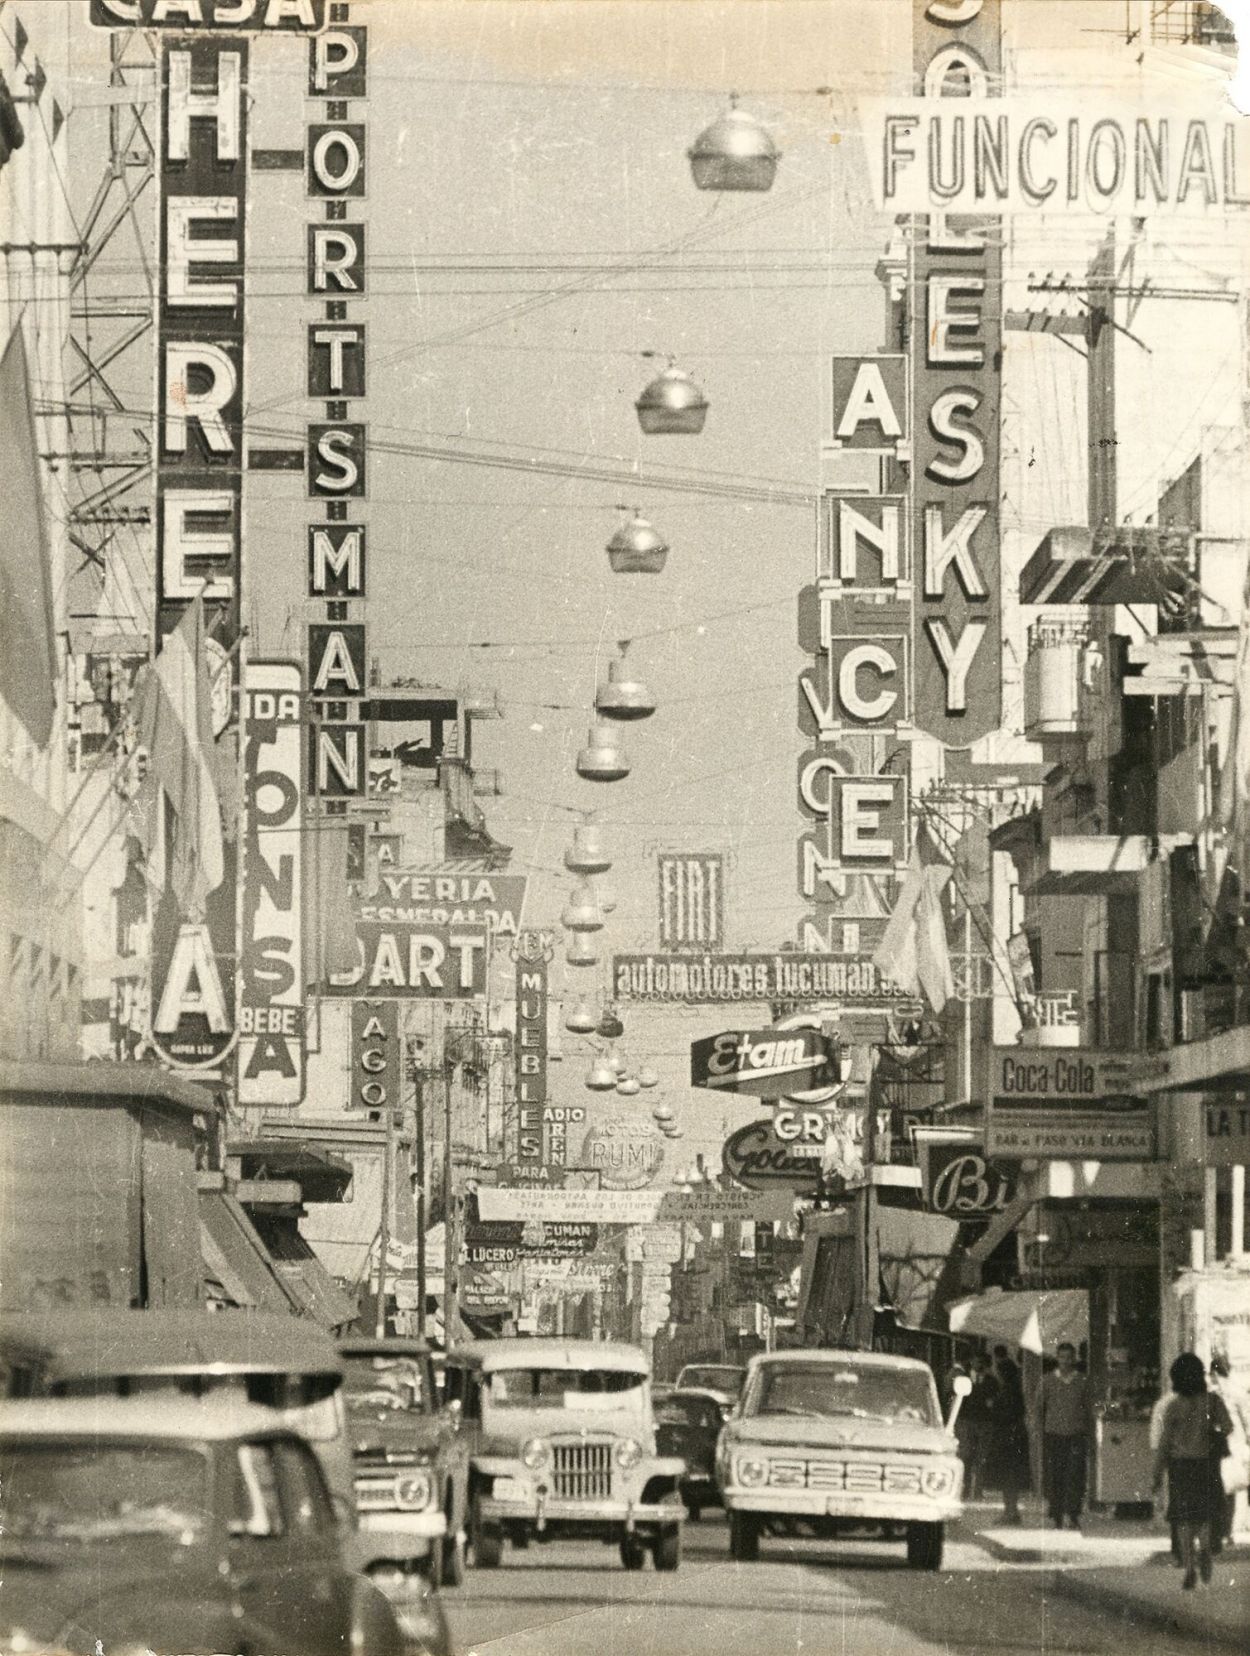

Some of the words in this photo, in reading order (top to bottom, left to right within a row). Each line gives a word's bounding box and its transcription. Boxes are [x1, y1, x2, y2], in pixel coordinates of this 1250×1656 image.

[883, 115, 1250, 205] FUNCIONAL
[662, 861, 721, 941] FIAT
[239, 1008, 297, 1034] BEBE
[520, 972, 542, 1157] MUEBLES
[707, 1033, 822, 1076] Etam
[1002, 1056, 1095, 1094] Coca-Cola
[472, 1247, 515, 1262] LUCERO
